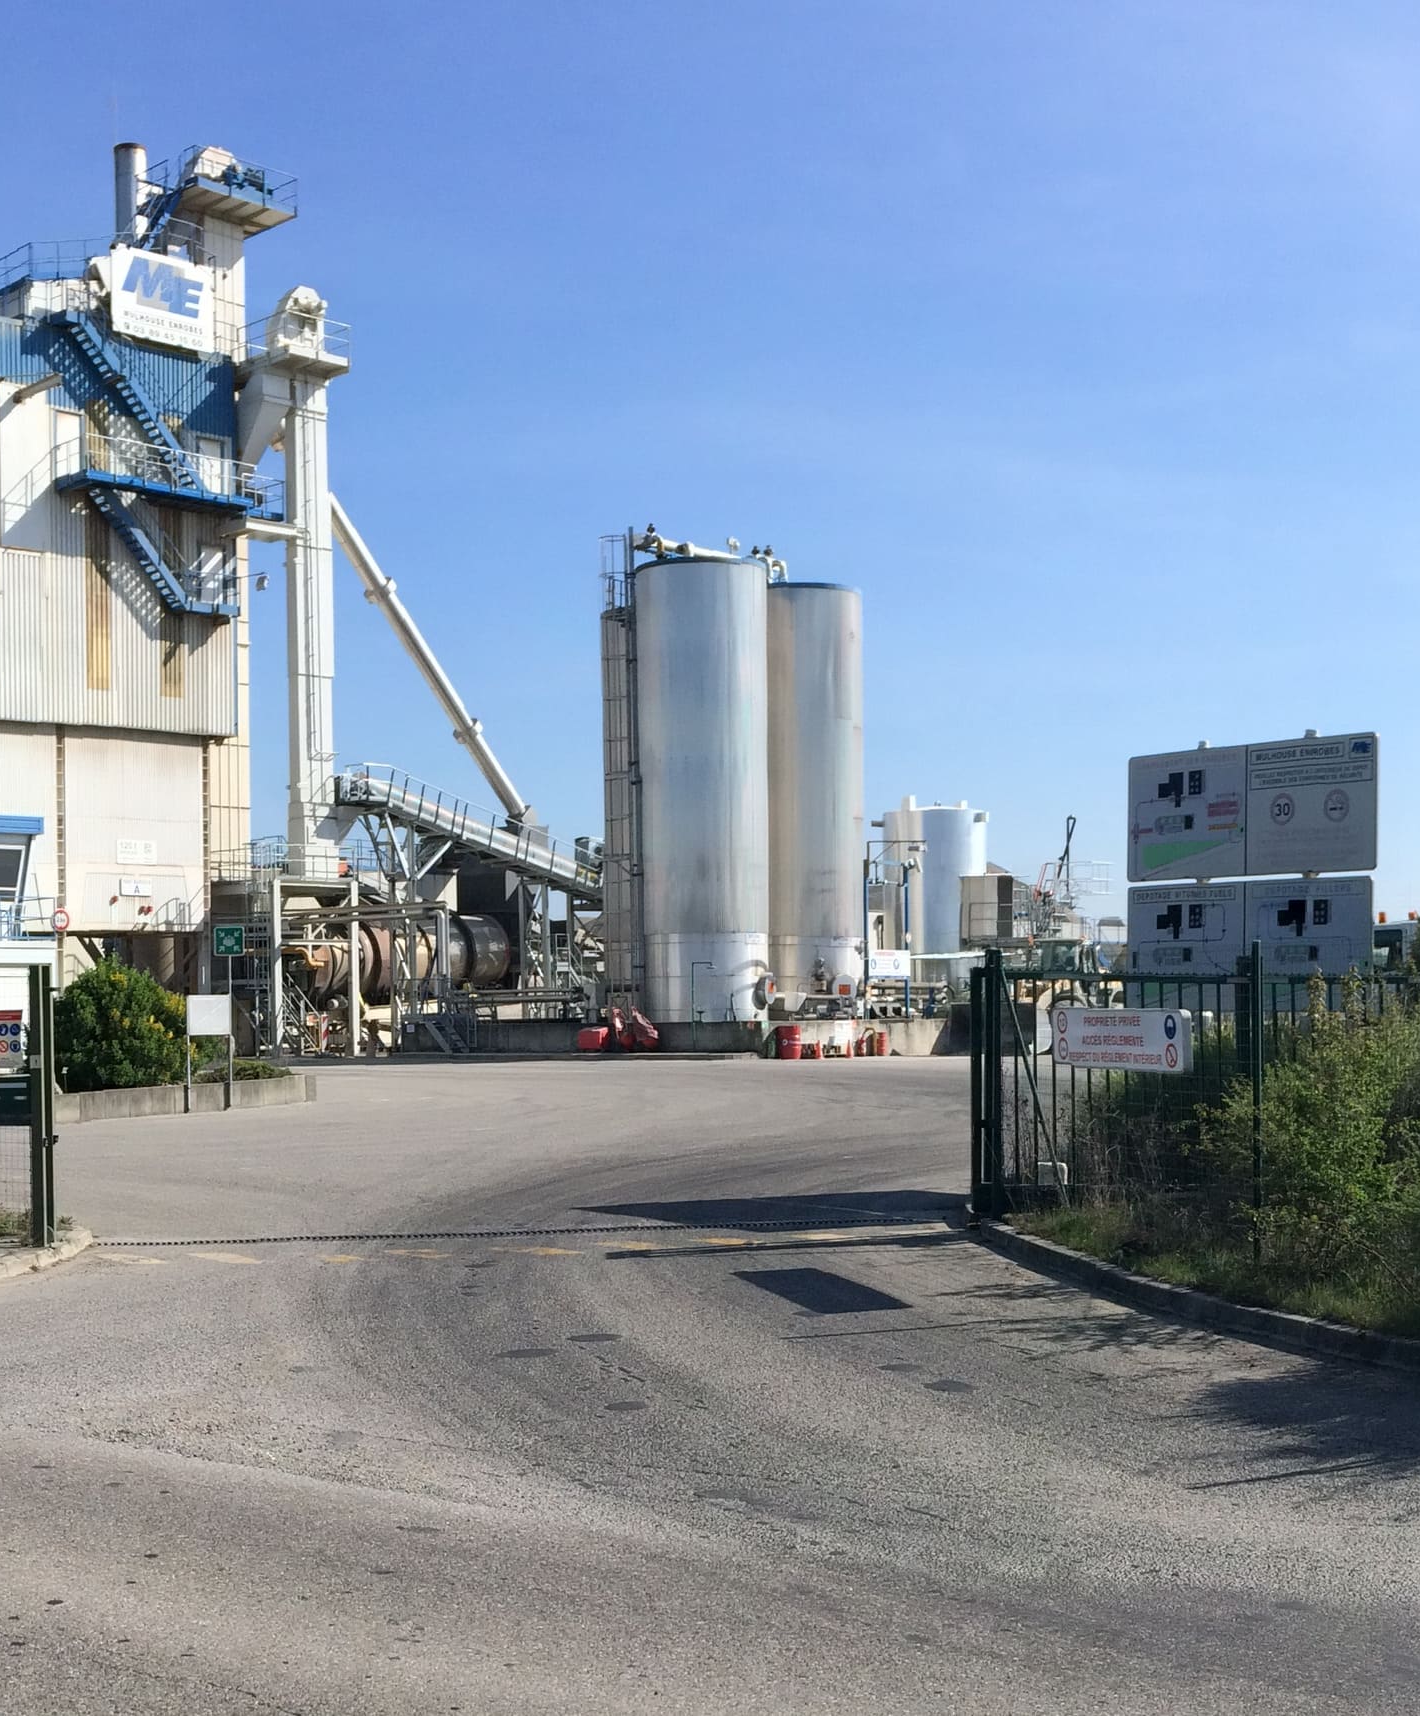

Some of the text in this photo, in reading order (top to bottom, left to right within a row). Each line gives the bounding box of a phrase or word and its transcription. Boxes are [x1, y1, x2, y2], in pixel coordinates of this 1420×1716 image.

[121, 255, 204, 319] ME
[123, 310, 165, 327] MULHOUSE
[1256, 749, 1296, 761] MULHOUSE
[1275, 803, 1290, 817] 30
